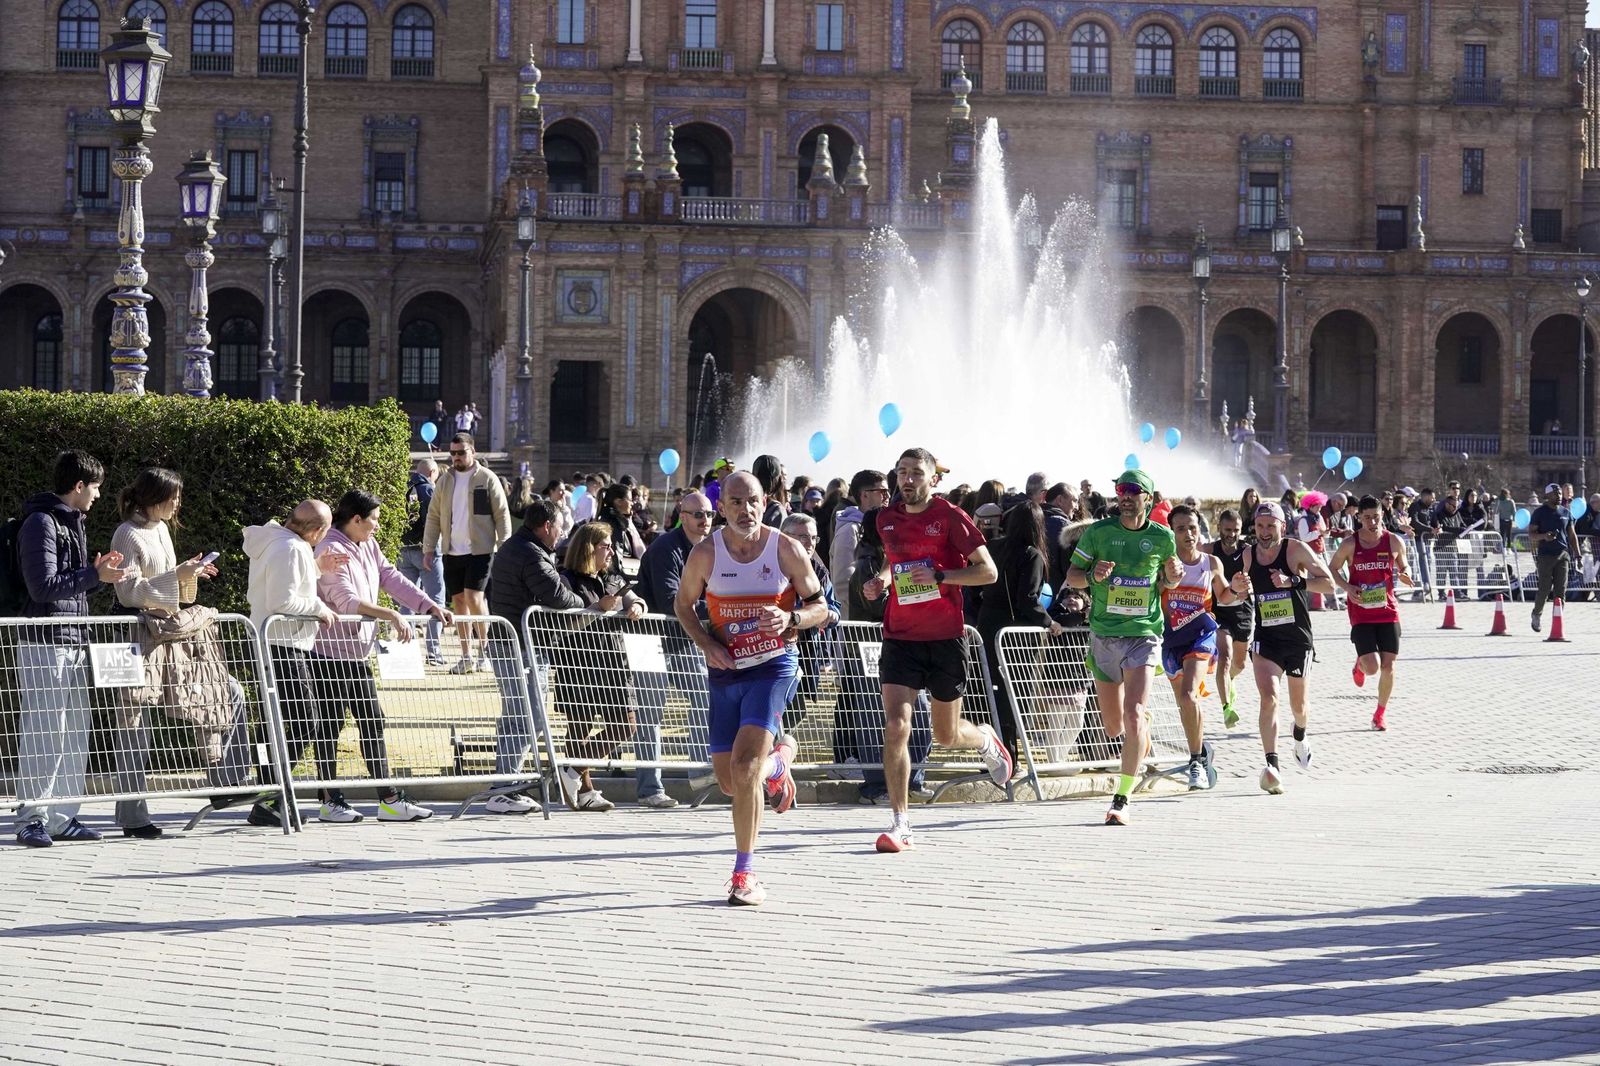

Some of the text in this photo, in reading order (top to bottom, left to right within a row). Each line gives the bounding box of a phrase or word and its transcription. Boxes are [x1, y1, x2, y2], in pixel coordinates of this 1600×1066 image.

[1354, 562, 1390, 571] VENEZUELA
[900, 584, 933, 595] BASTIEN
[1115, 597, 1143, 607] PERICO
[1264, 608, 1288, 618] MARCO
[734, 638, 779, 658] GALLEGO
[105, 649, 133, 667] AMS
